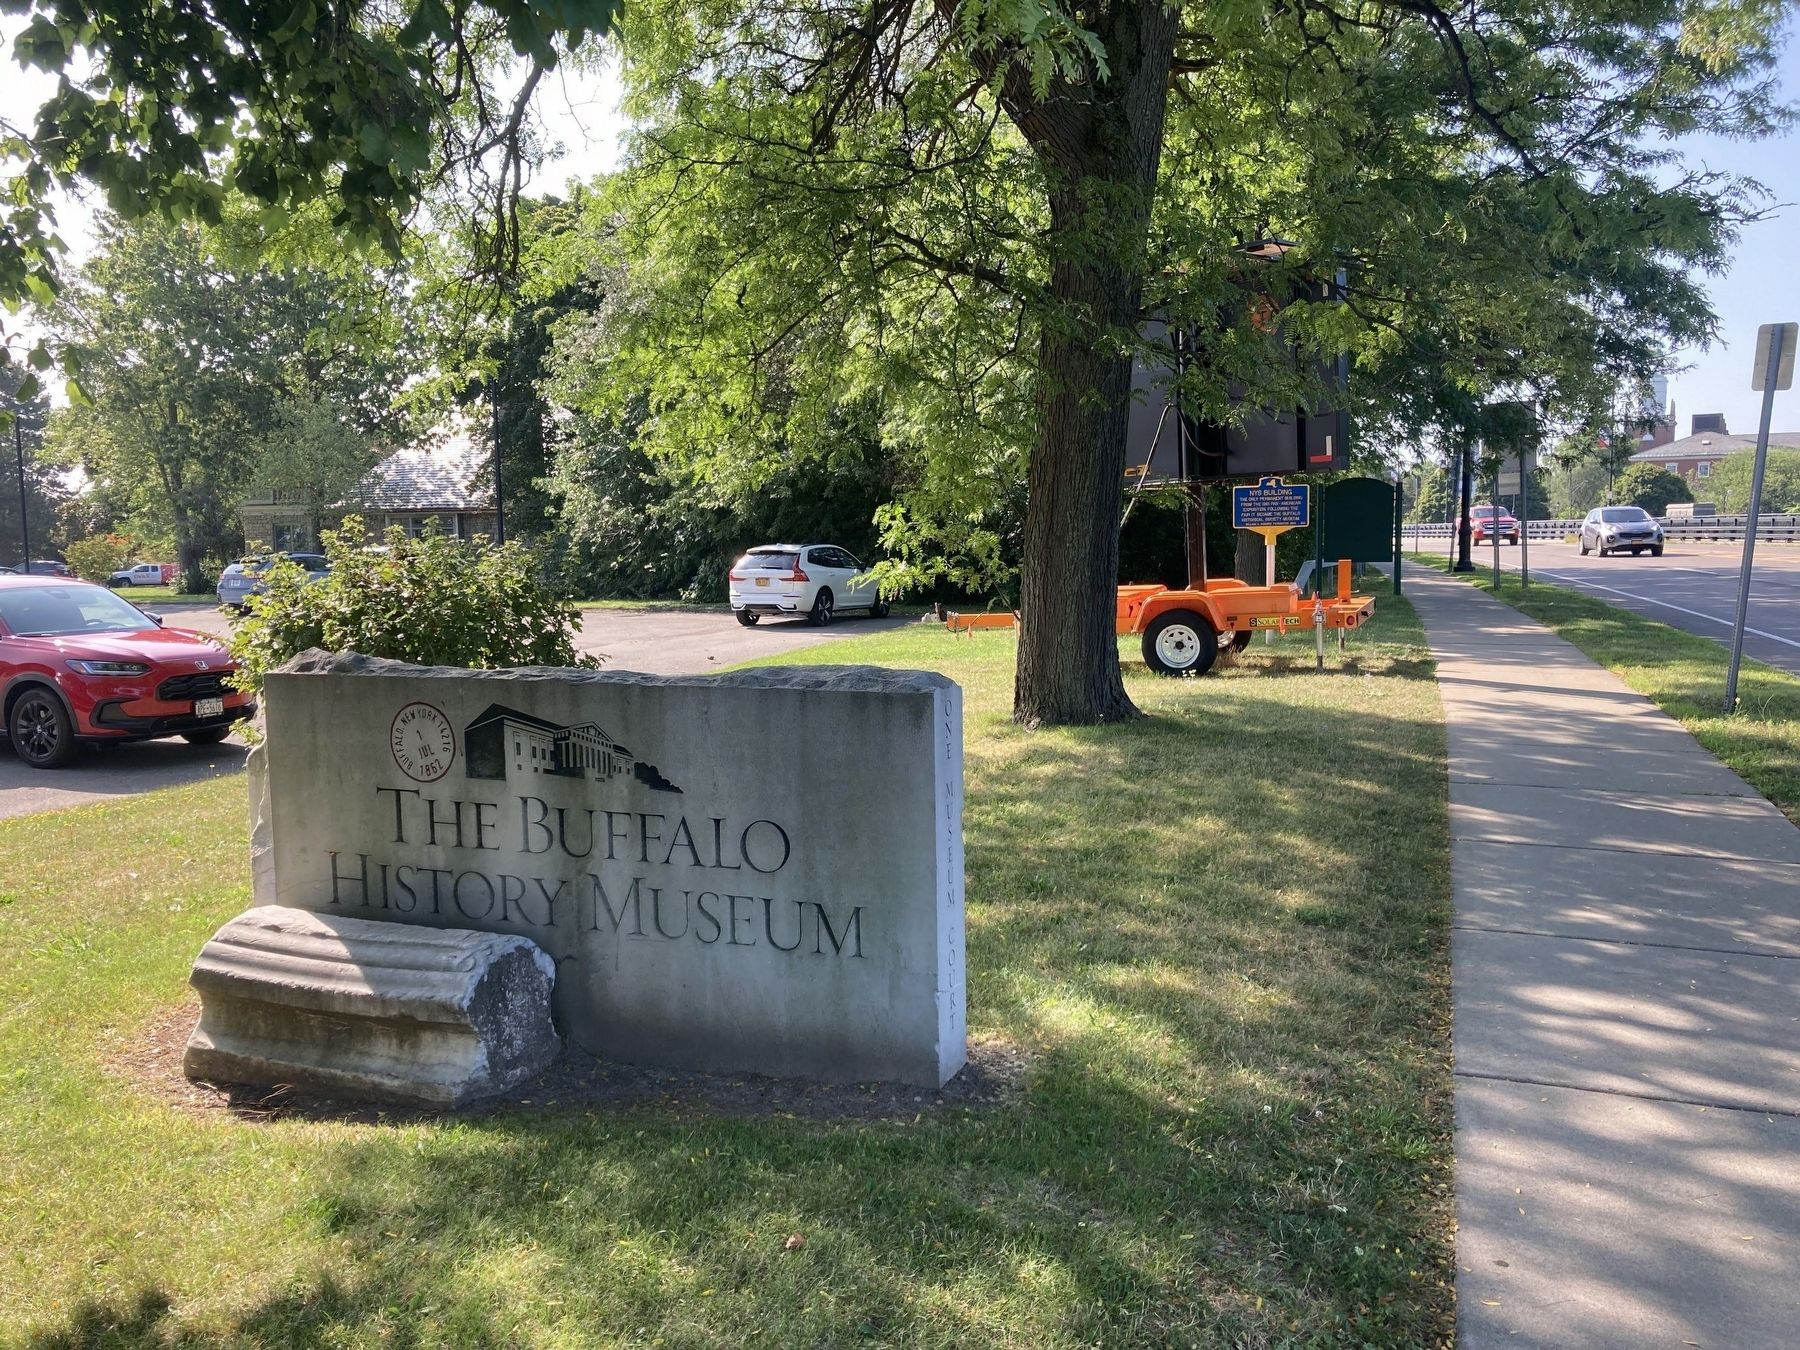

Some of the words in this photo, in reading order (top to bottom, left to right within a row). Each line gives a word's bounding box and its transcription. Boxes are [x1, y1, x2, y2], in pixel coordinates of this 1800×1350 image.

[401, 710, 416, 726] NEW
[417, 708, 438, 723] YORK
[437, 721, 451, 753] 14216
[418, 744, 435, 759] JUL
[944, 699, 953, 760] ONE
[420, 758, 444, 777] 1862
[376, 786, 501, 850] THE
[518, 795, 792, 873] BUFFALO
[945, 781, 955, 905] MUSEUM
[329, 850, 569, 927] HISTORY
[589, 873, 868, 959] MUSEUM
[948, 926, 956, 1030] COURT
